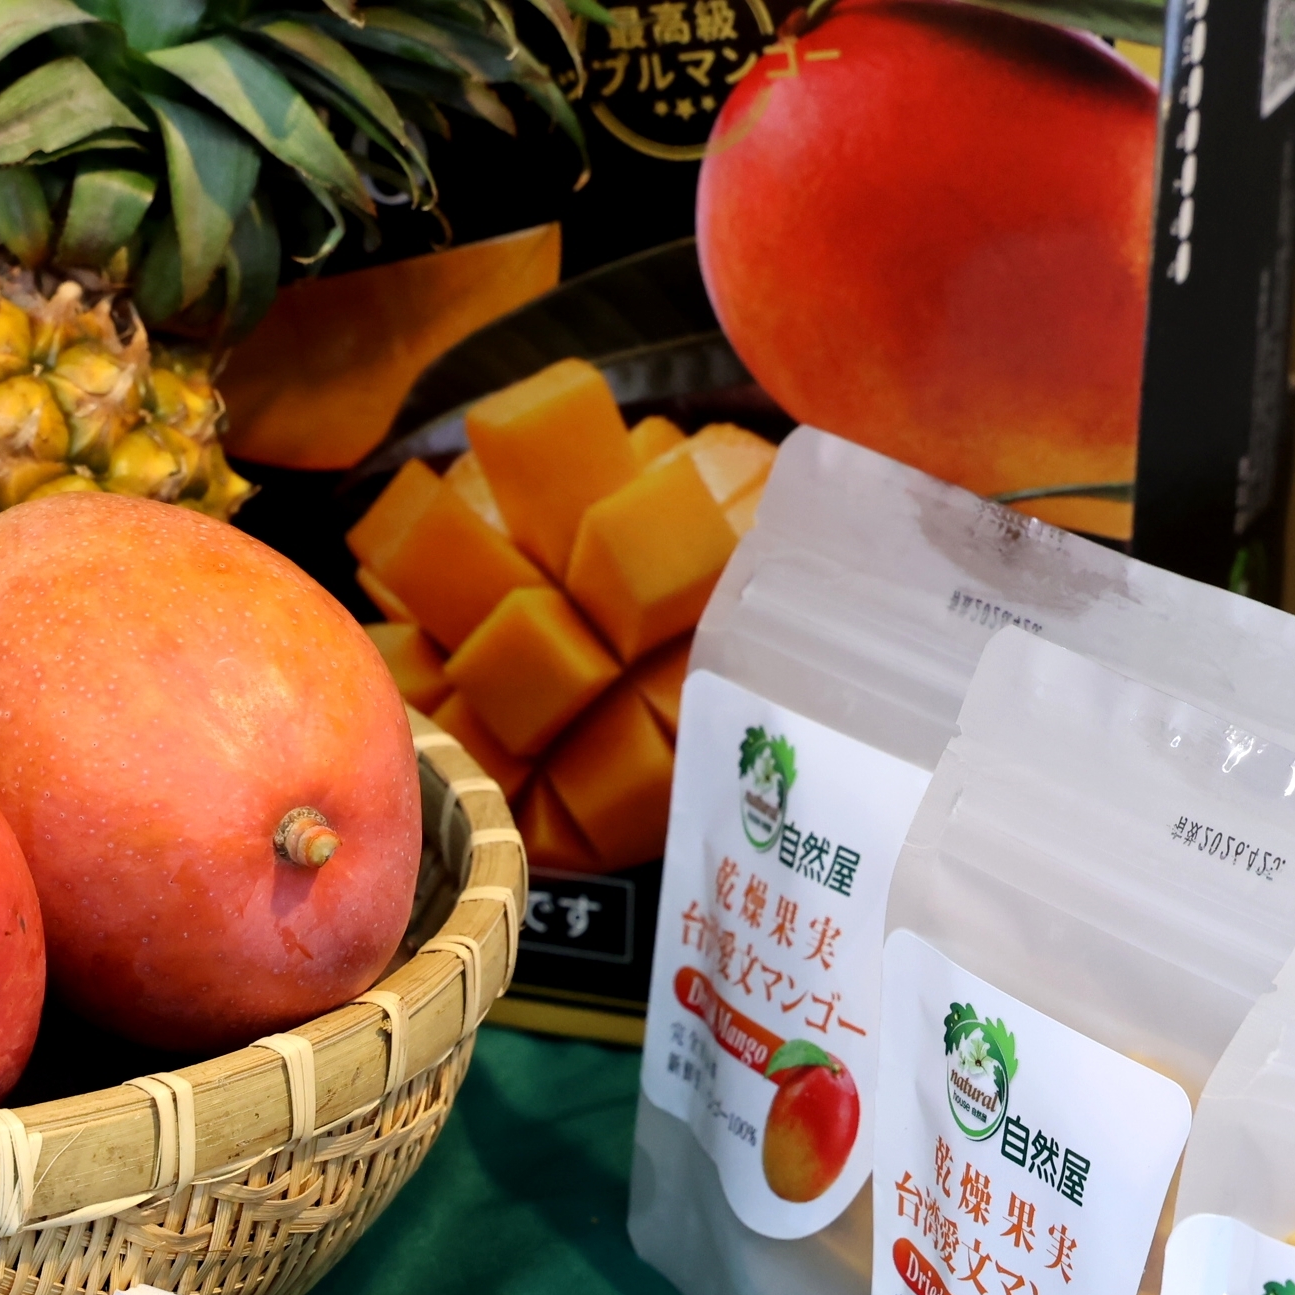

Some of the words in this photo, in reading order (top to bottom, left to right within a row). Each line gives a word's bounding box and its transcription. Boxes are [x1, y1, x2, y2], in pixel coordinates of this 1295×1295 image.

[779, 821, 861, 897] 自然屋
[950, 1067, 999, 1112] natural
[953, 1089, 971, 1112] house
[1001, 1115, 1090, 1207] 自然屋
[934, 1134, 1078, 1285] 乾燥果実
